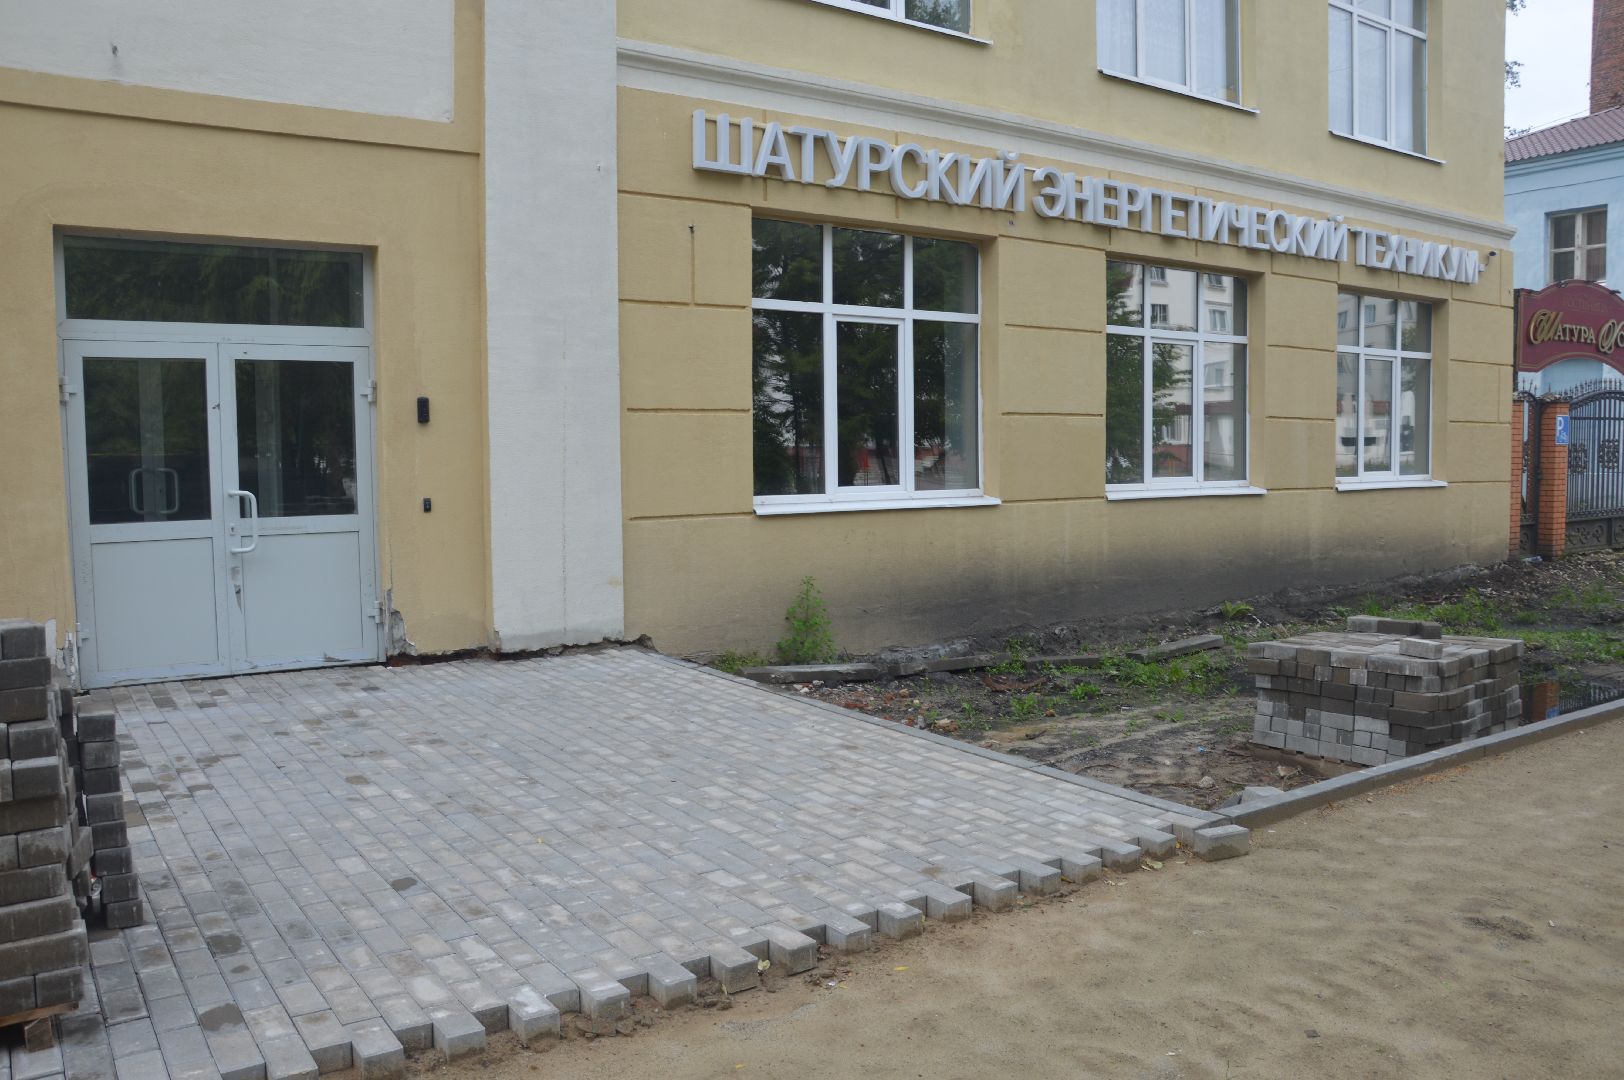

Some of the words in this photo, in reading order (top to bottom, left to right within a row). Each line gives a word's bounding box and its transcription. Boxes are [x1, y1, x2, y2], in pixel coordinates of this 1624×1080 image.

[692, 109, 1025, 212] ШАТУРСКИЙ
[1032, 167, 1348, 262] ЭНЕРГЕТИЧЕСКИЙ
[1350, 227, 1479, 284] ТЕХНИКУМ
